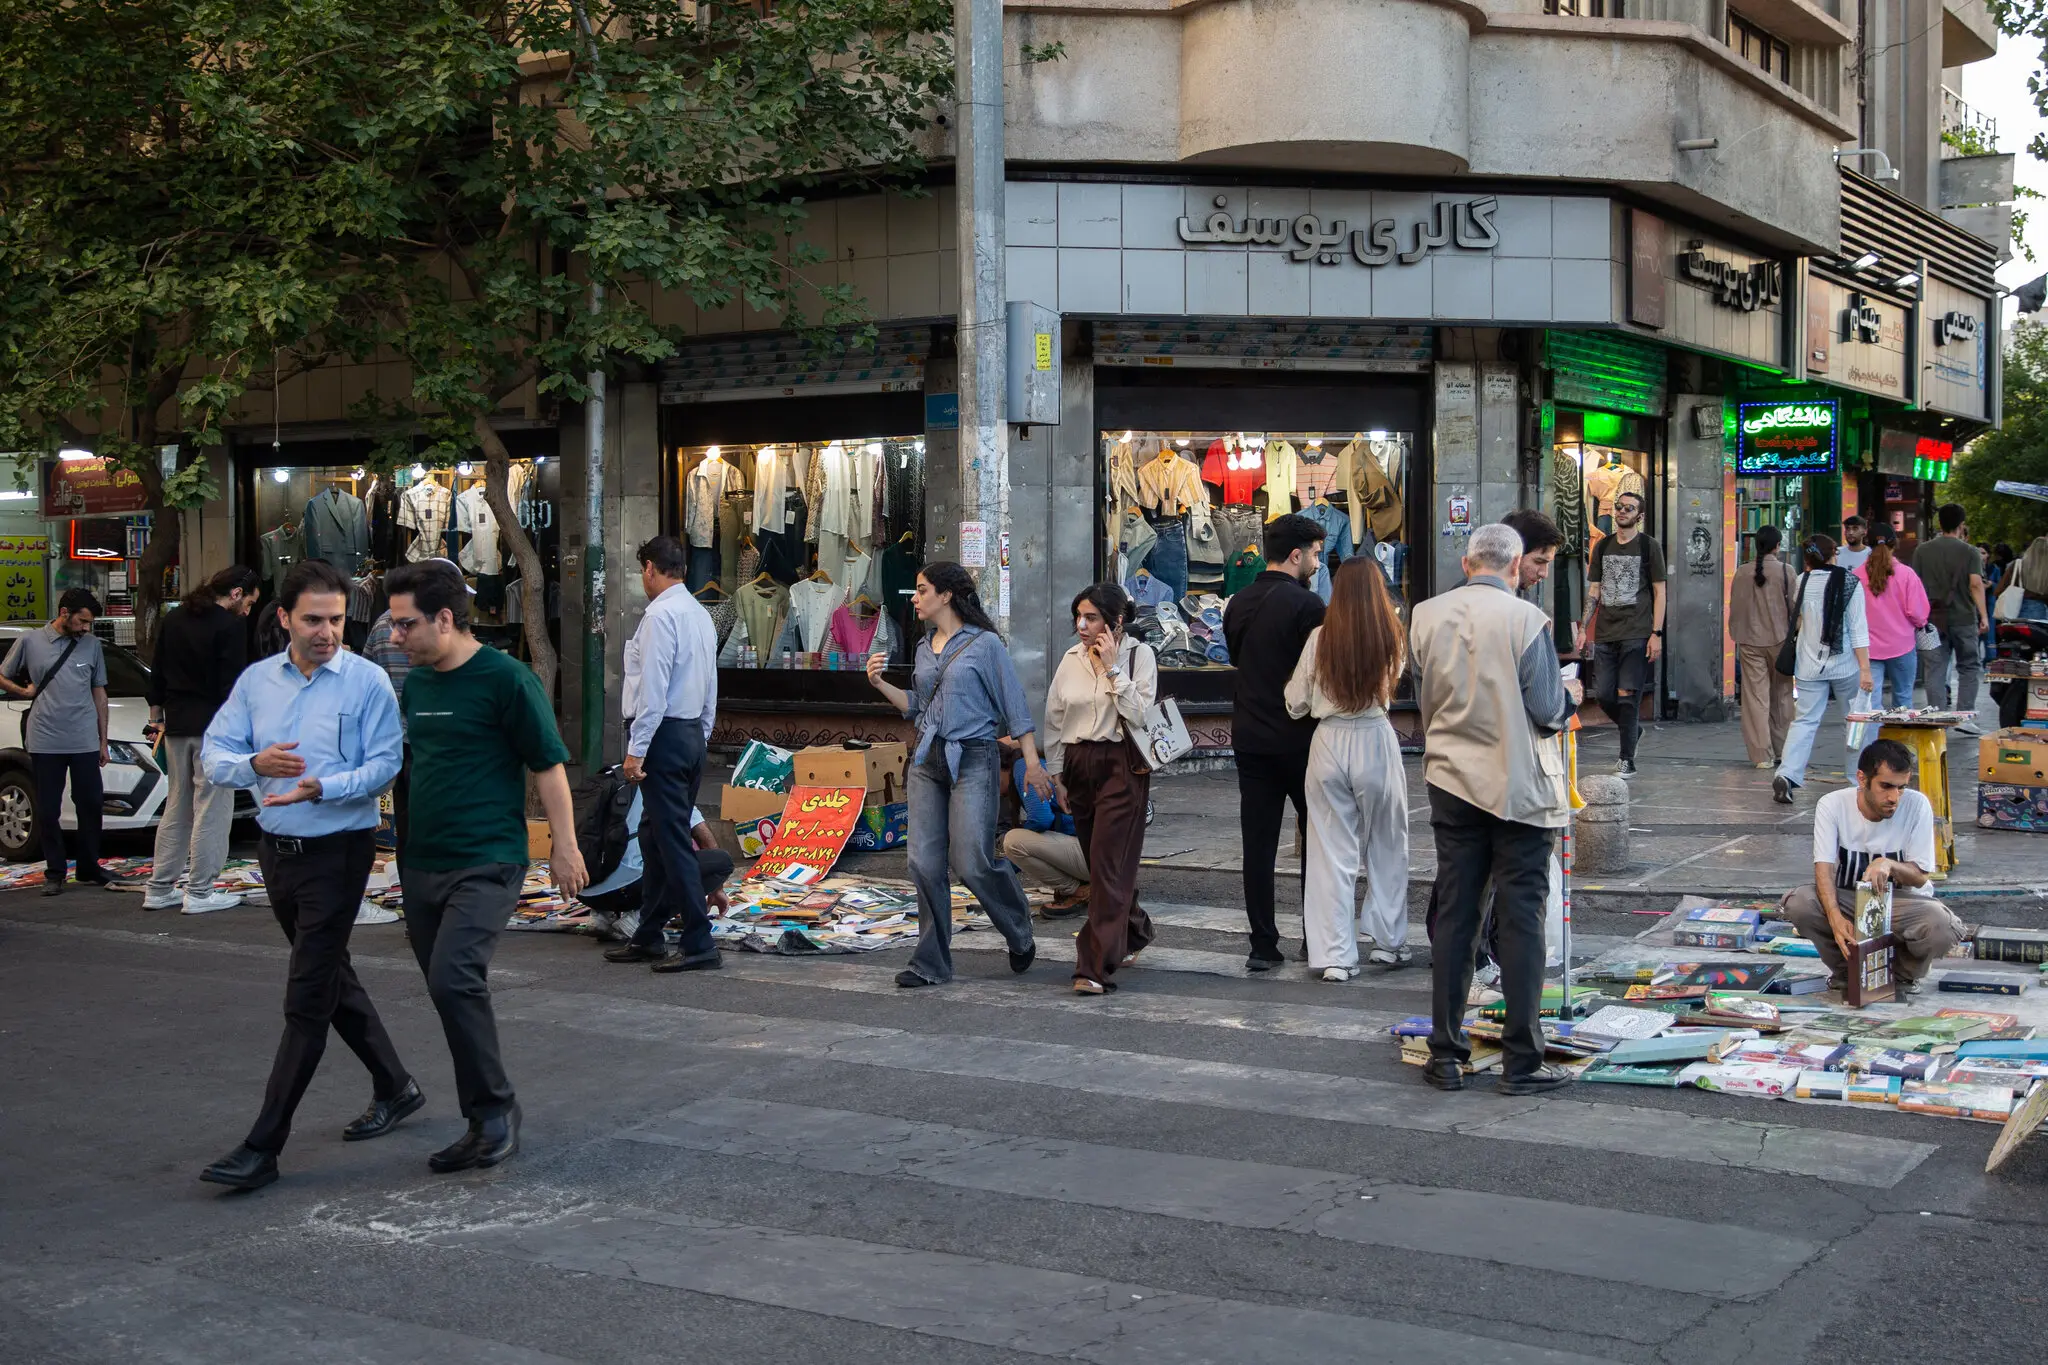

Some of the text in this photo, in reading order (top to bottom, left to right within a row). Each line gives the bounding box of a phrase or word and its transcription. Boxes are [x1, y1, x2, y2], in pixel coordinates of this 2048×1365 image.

[1177, 194, 1500, 266] گالری یوسف
[1682, 239, 1740, 306] یوسف
[1740, 261, 1782, 311] گالری
[1743, 405, 1832, 434] دانشگاهی
[27, 540, 48, 553] کتاب
[6, 571, 33, 588] رمان
[7, 592, 36, 608] تاریخ
[800, 788, 851, 814] جلدی
[782, 818, 845, 841] ۳۰/۰۰۰
